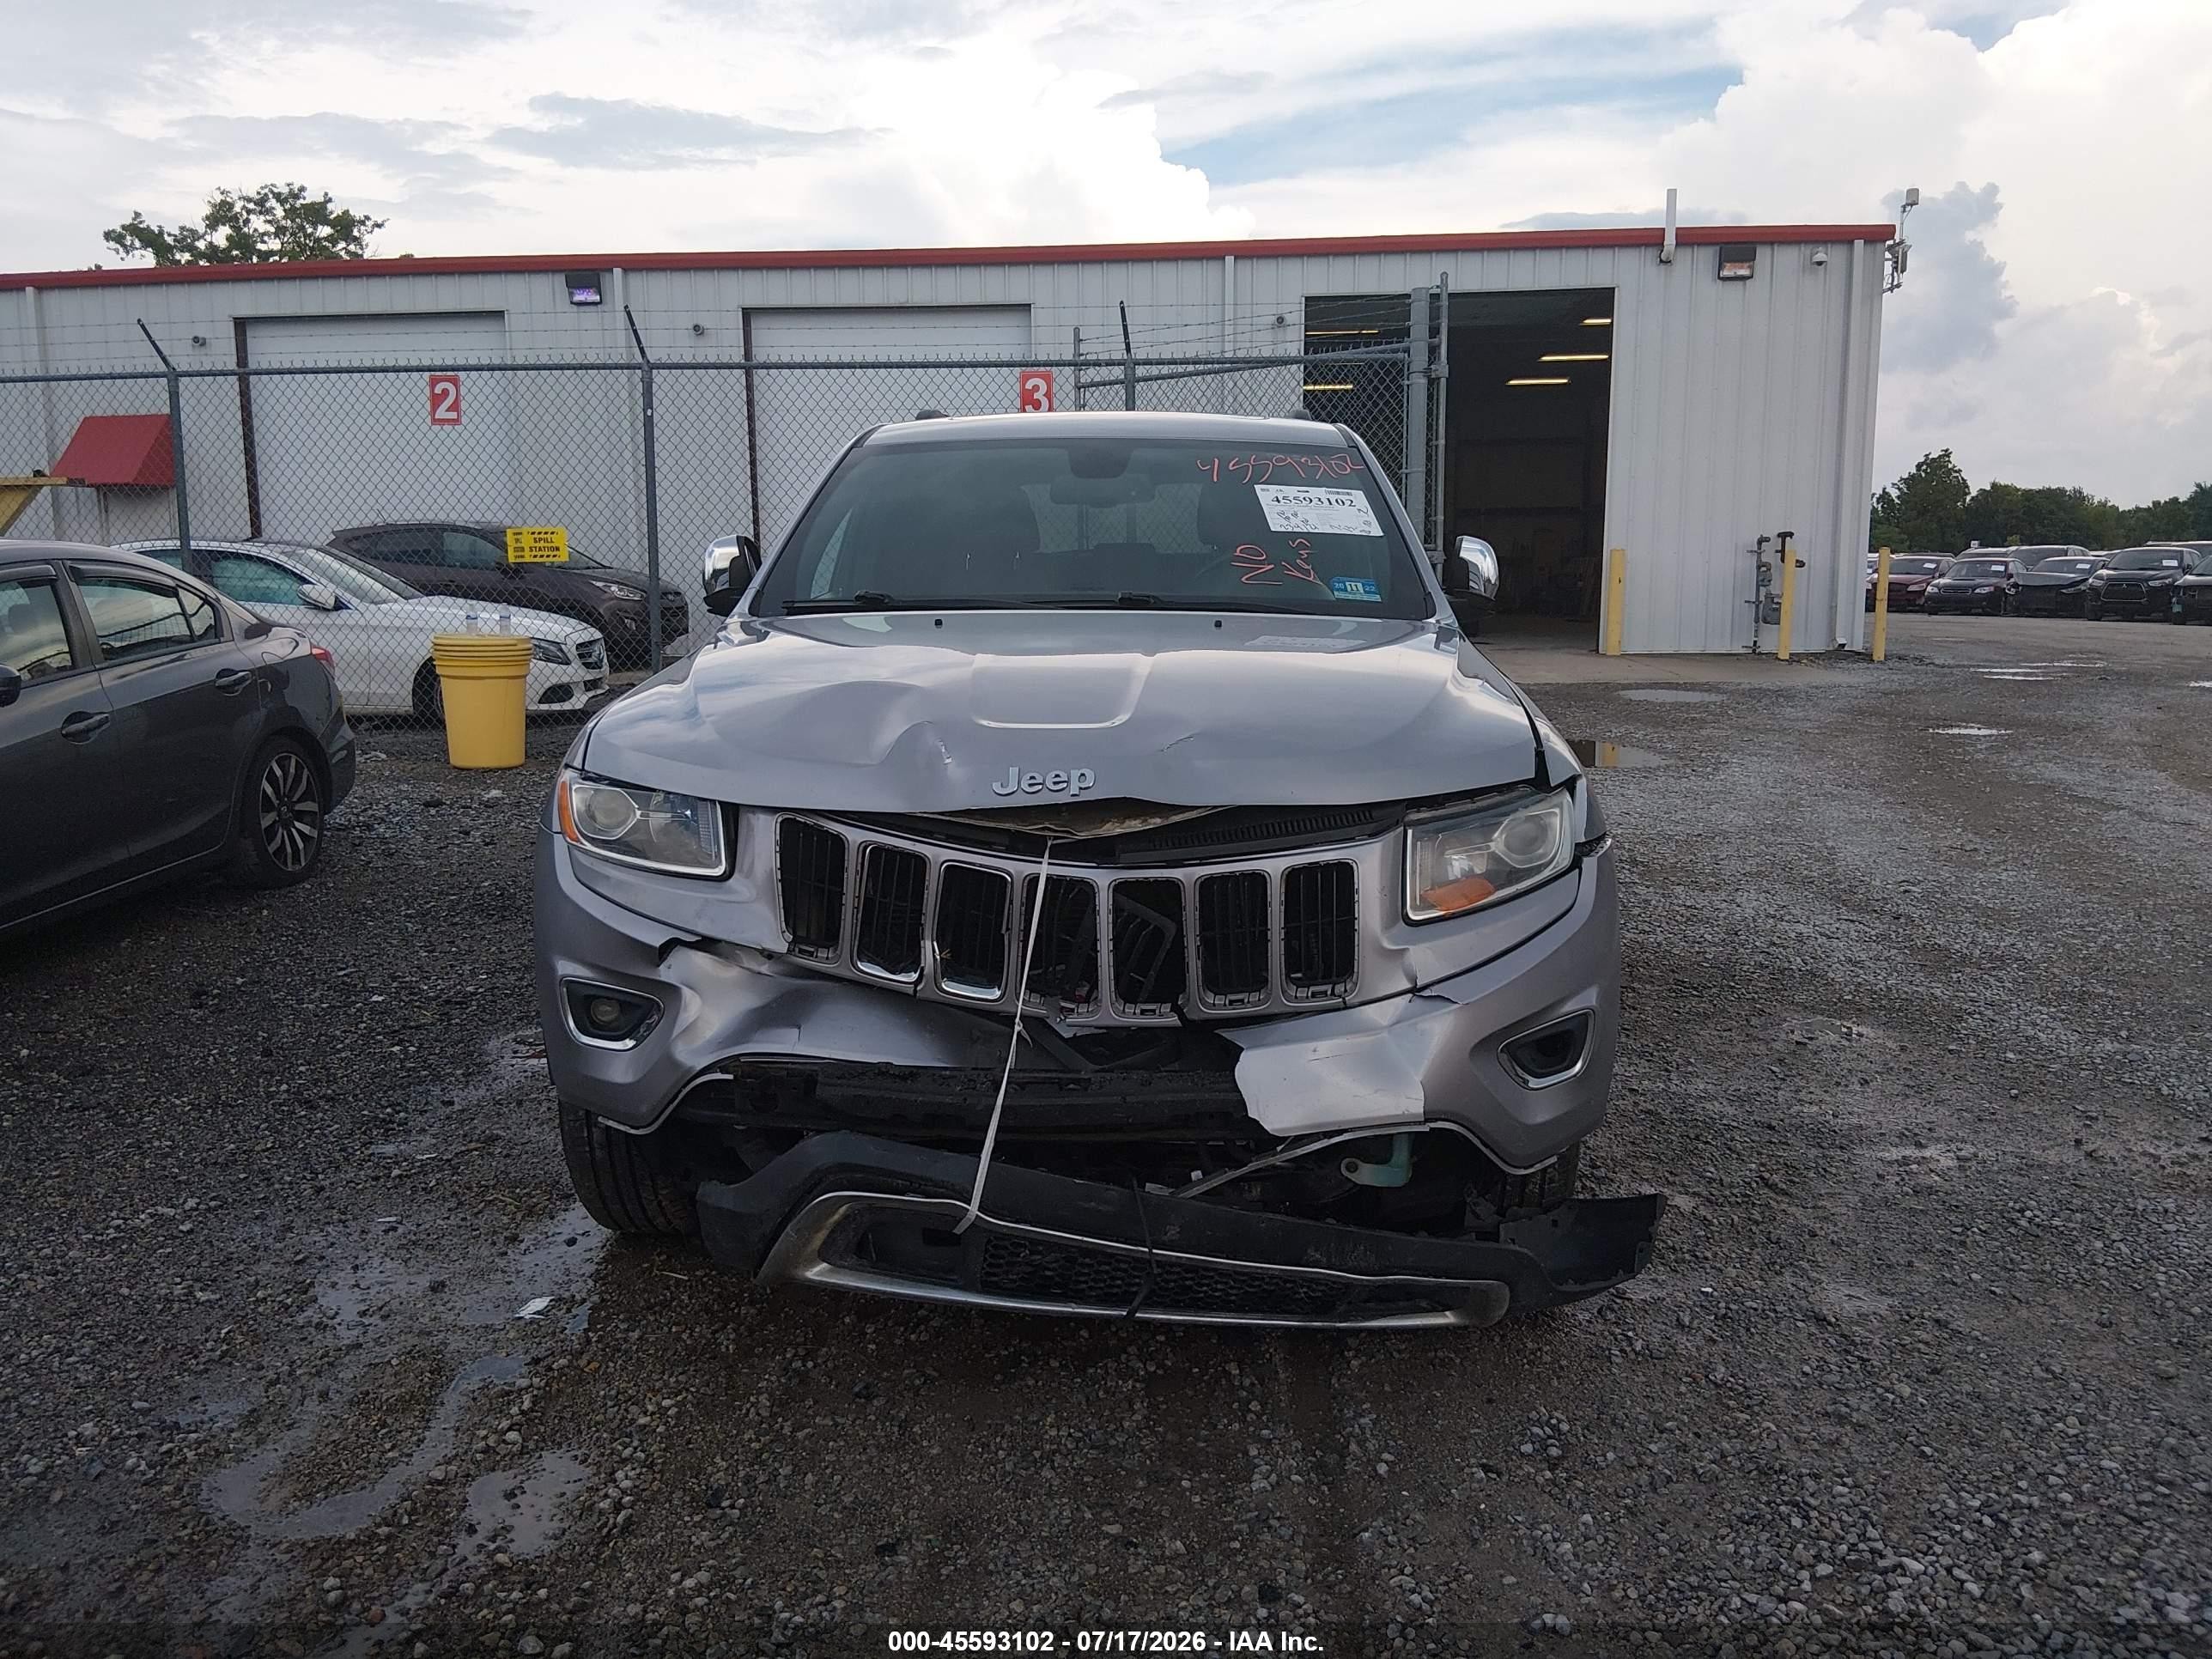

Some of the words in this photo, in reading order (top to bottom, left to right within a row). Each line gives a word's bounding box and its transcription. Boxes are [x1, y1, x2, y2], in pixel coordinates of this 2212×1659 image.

[434, 381, 458, 419] 2
[1025, 378, 1049, 413] 3
[1272, 495, 1357, 507] 45593102
[1230, 544, 1283, 586] NO
[1347, 583, 1361, 592] 11
[992, 767, 1096, 797] Jeep
